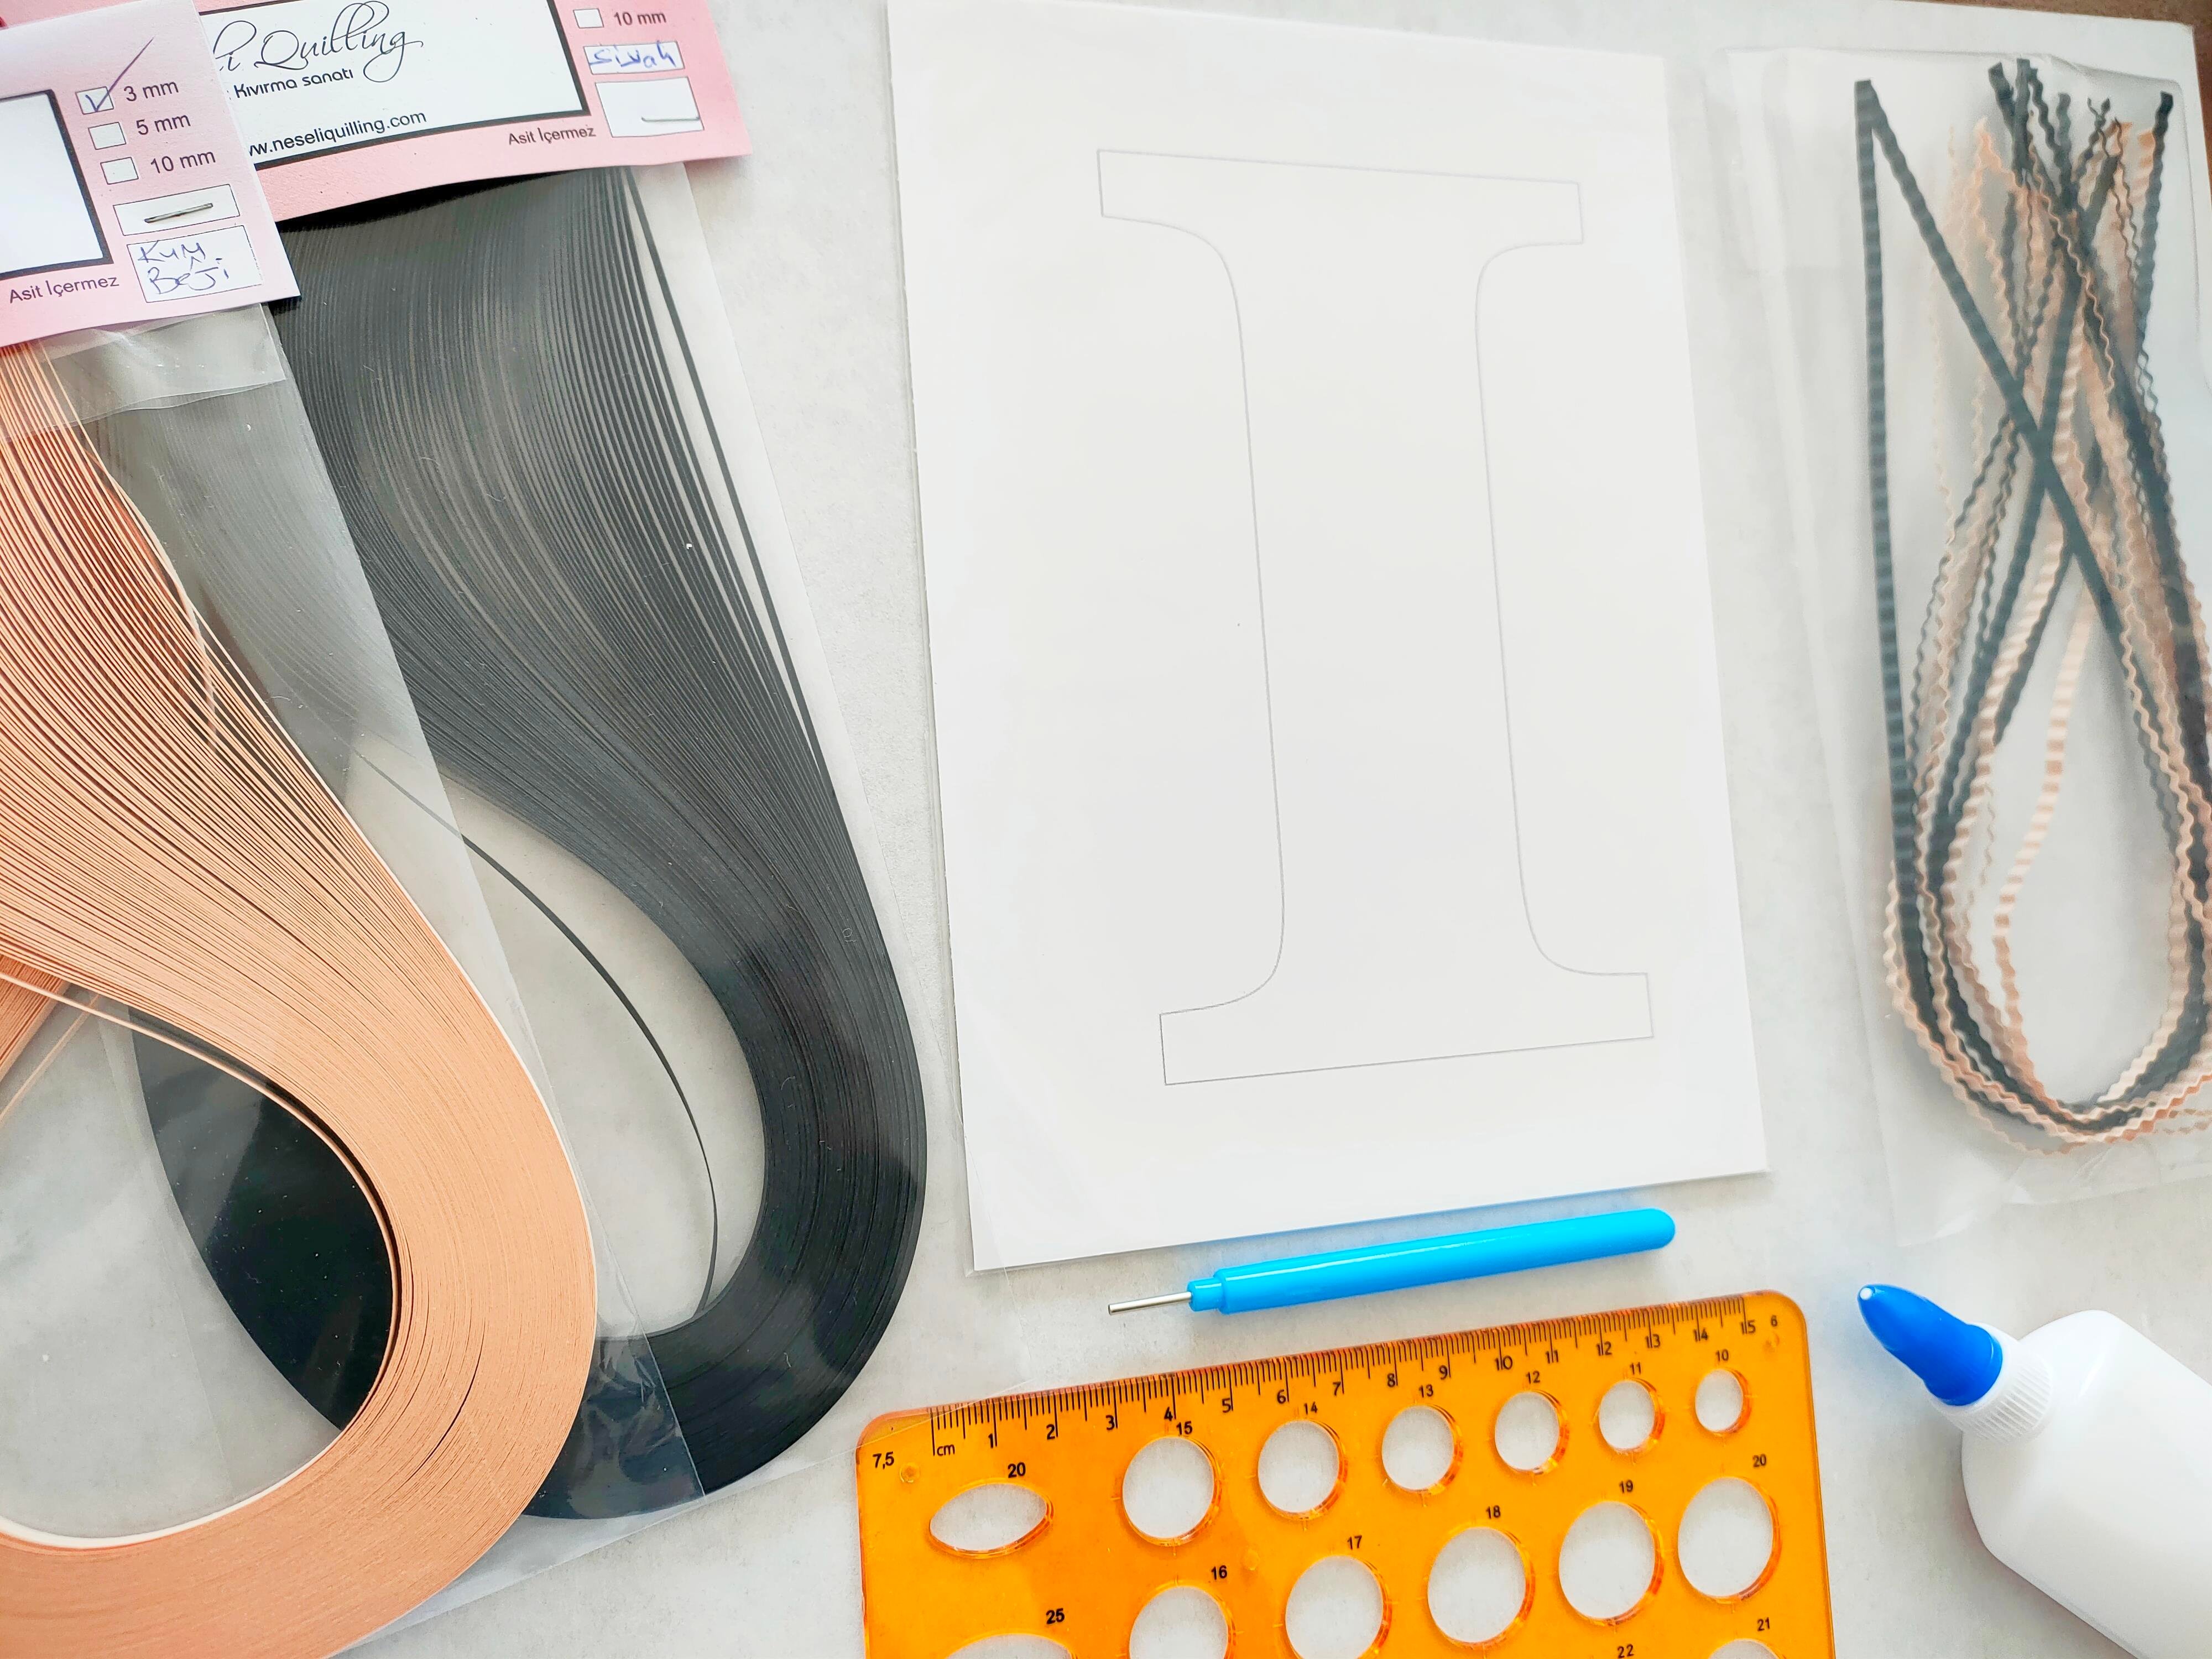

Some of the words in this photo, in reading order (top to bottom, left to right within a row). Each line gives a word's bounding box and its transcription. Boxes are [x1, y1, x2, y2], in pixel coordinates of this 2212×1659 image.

[614, 12, 633, 26] 10
[637, 12, 667, 25] mm
[253, 1, 424, 83] Quilling
[124, 86, 137, 102] 3
[142, 80, 179, 98] mm
[137, 119, 149, 135] 5
[154, 114, 191, 133] mm
[248, 111, 427, 156] w.neseliquilling.com
[508, 132, 536, 145] Asit
[150, 157, 174, 175] 10
[179, 151, 216, 169] mm
[9, 285, 43, 304] Asit
[1715, 1349, 1729, 1361] 10
[1629, 1363, 1642, 1375] 11
[1525, 1370, 1541, 1384] 12
[937, 1443, 955, 1457] cm
[1046, 1423, 1055, 1440] 2
[1106, 1414, 1115, 1431] 3
[1164, 1406, 1173, 1422] 4
[1222, 1397, 1232, 1413] 5
[1276, 1389, 1286, 1405] 6
[1332, 1381, 1341, 1397] 7
[1386, 1373, 1396, 1388] 8
[1438, 1364, 1448, 1380] 9
[1494, 1355, 1513, 1370] 10
[1596, 1341, 1612, 1356] 12
[1645, 1333, 1661, 1348] 13
[1693, 1327, 1708, 1342] 14
[1740, 1320, 1756, 1334] 15
[1418, 1384, 1434, 1399] 13
[1303, 1402, 1318, 1415] 14
[1176, 1421, 1193, 1435] 15
[873, 1451, 895, 1469] 7,5
[1752, 1454, 1767, 1468] 20
[1007, 1462, 1026, 1479] 20
[1619, 1480, 1634, 1494] 19
[1485, 1505, 1501, 1519] 18
[1347, 1536, 1363, 1550] 17
[1211, 1566, 1228, 1580] 16
[1046, 1608, 1065, 1625] 25
[1757, 1617, 1771, 1632] 21
[1617, 1644, 1634, 1659] 22
